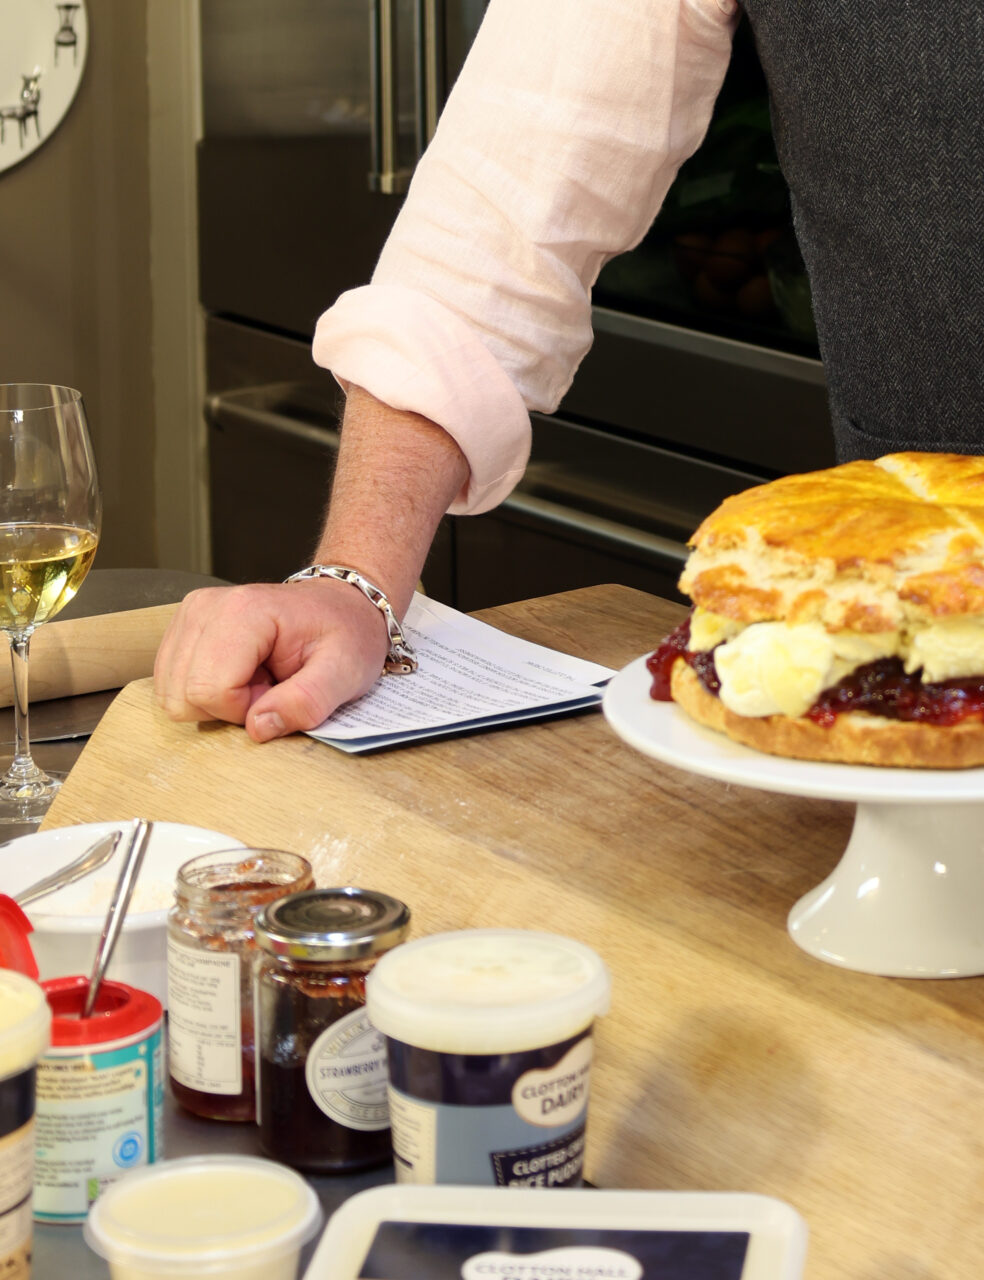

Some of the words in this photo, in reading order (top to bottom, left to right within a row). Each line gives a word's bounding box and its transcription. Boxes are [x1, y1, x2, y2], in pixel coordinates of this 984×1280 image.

[319, 1060, 380, 1079] STRAWBERRY
[521, 1073, 577, 1099] CLOTTON
[512, 1147, 568, 1177] CLOTTED
